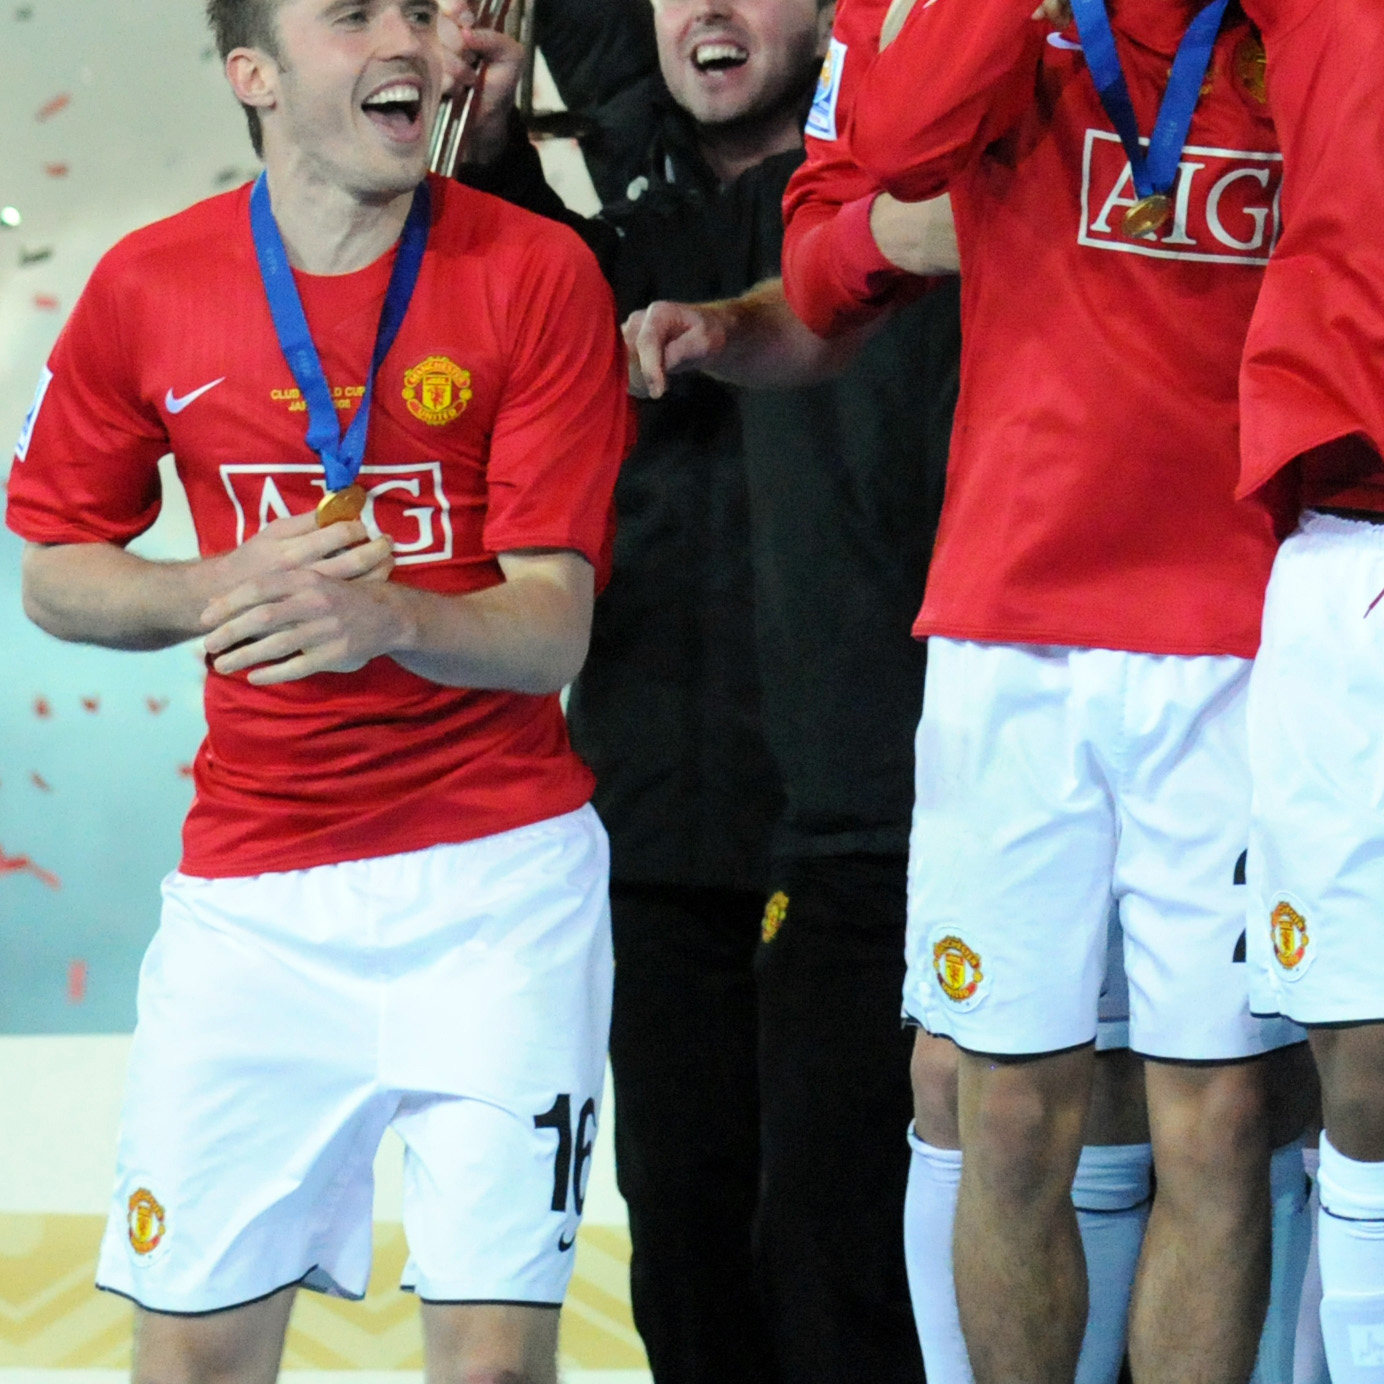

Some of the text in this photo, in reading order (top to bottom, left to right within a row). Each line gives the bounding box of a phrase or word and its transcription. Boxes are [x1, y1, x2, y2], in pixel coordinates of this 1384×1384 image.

[1090, 161, 1270, 251] AIG
[270, 388, 300, 400] CLUB
[258, 476, 435, 553] AG
[533, 1093, 597, 1216] 16
